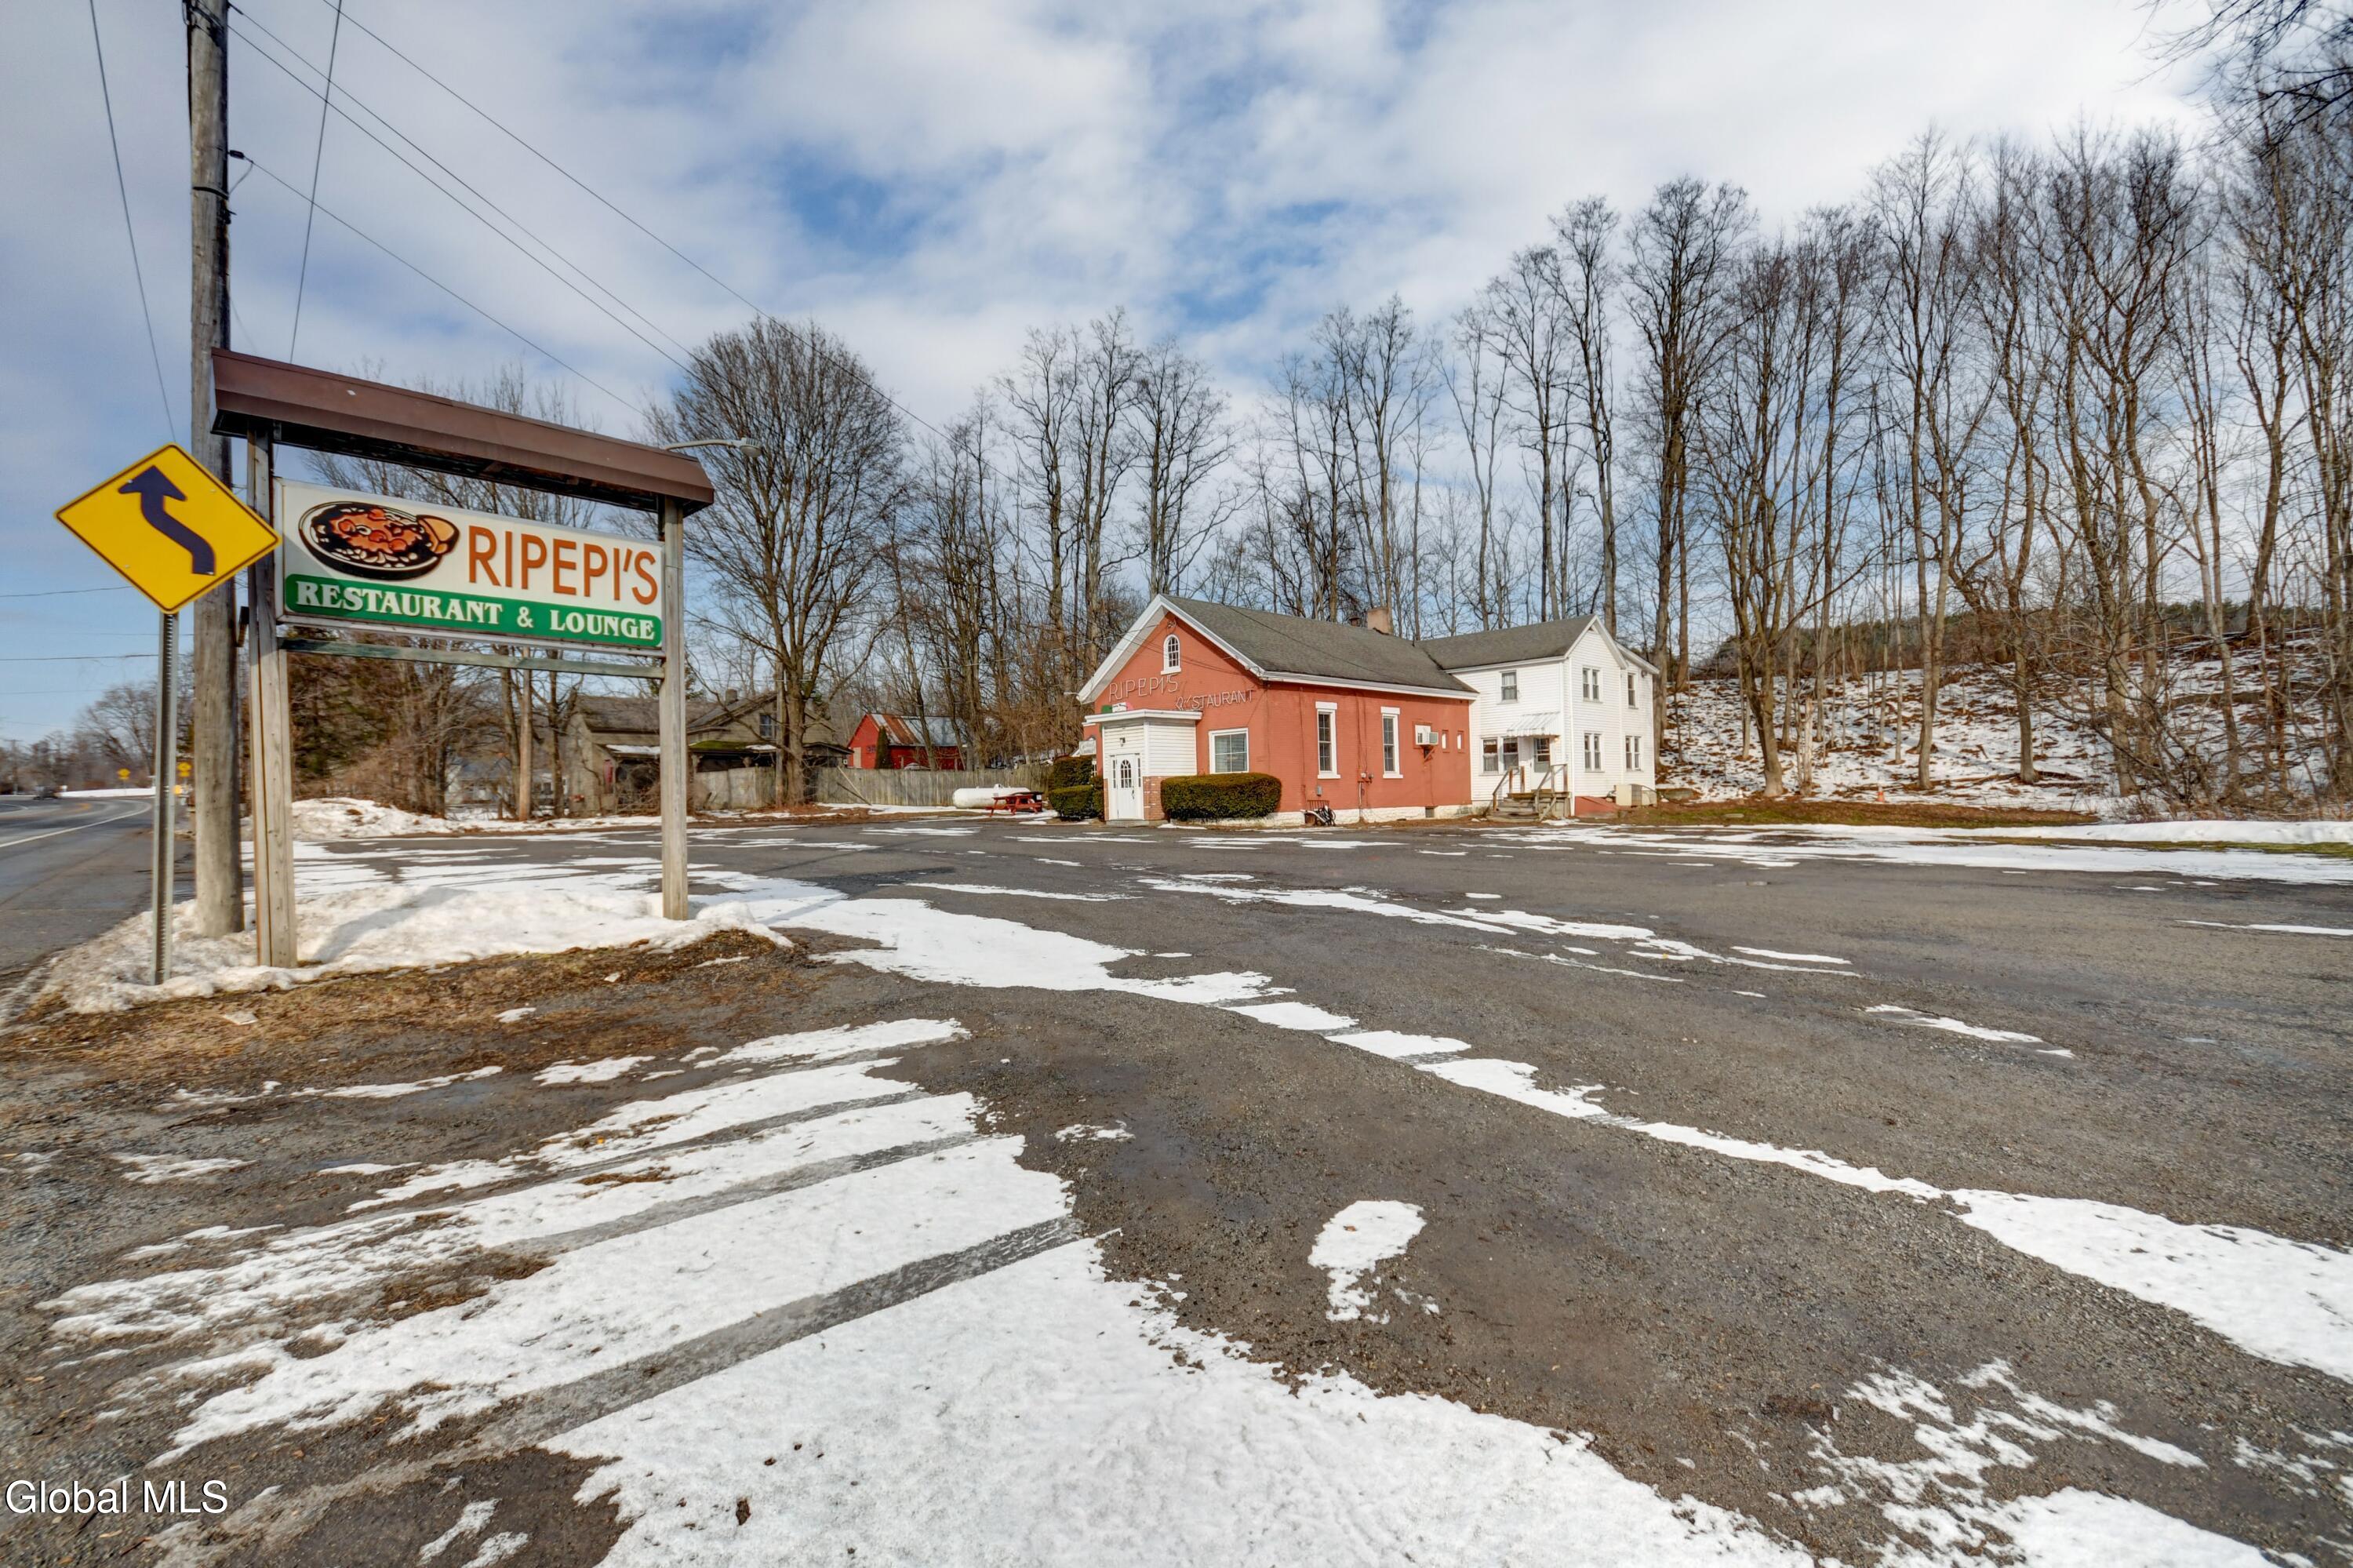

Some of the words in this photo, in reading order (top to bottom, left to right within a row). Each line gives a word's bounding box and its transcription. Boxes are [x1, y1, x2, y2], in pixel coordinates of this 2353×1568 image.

[469, 525, 658, 606] RIPEPI'S
[296, 580, 502, 625] RESTAURANT
[517, 606, 534, 628] &
[550, 609, 656, 640] LOUNGE
[1108, 675, 1178, 703] RIPEPI'S
